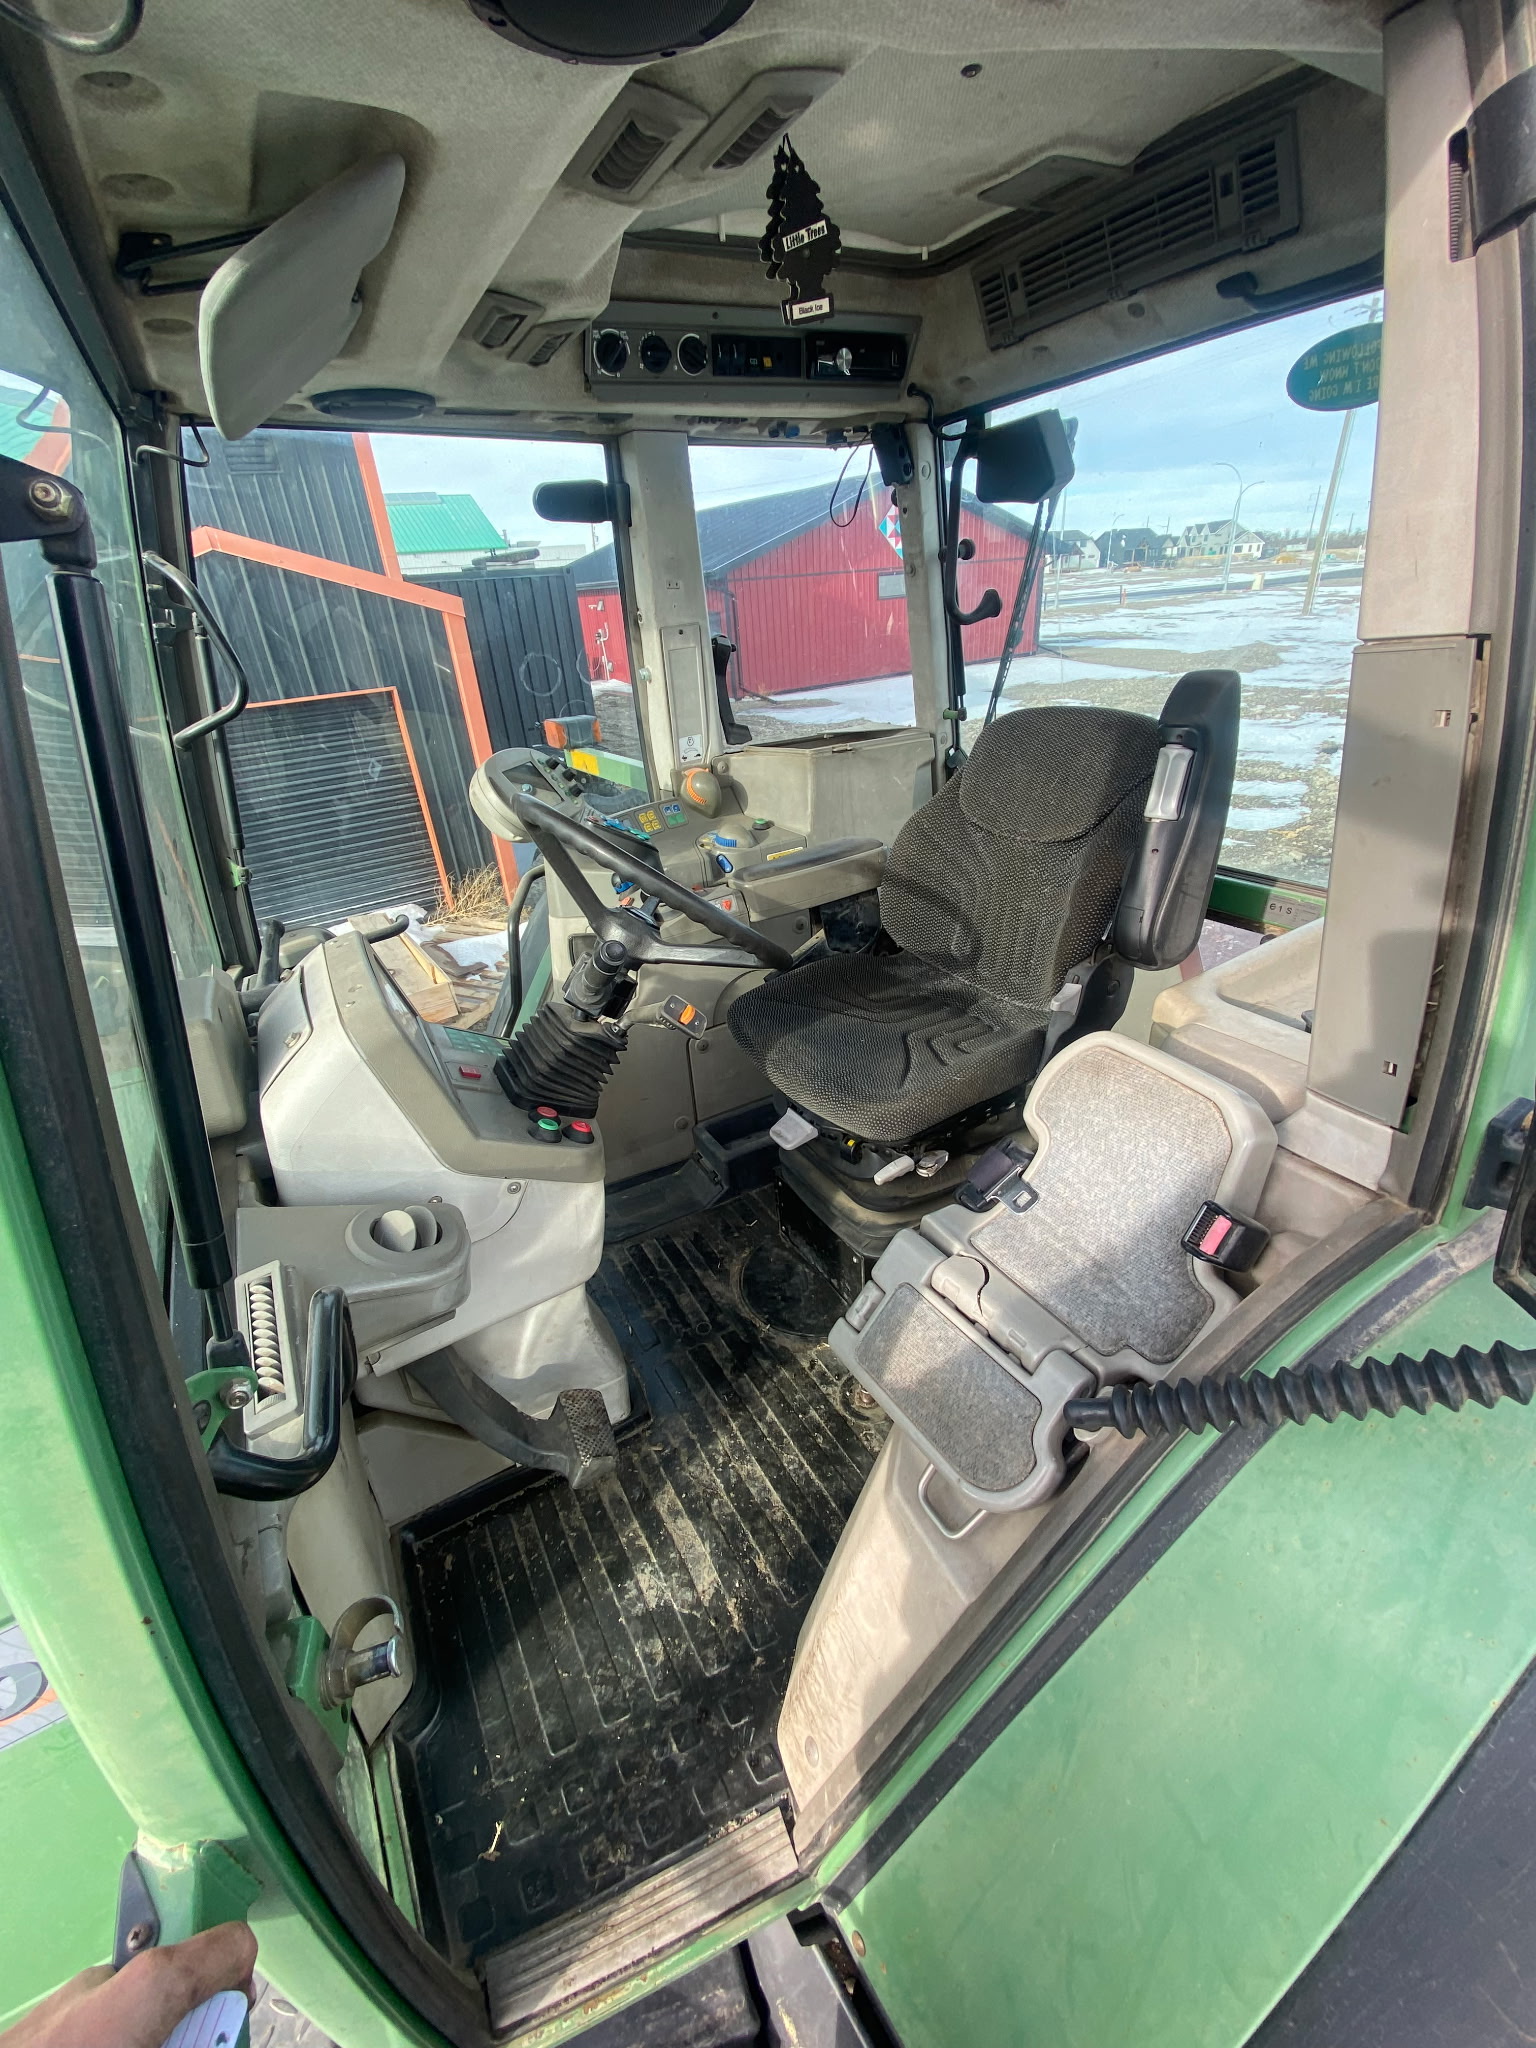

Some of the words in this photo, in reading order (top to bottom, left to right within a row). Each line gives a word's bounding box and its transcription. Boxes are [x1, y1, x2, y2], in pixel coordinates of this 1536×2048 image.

[785, 231, 805, 250] Little
[805, 225, 826, 241] Trees
[799, 305, 814, 315] Black
[815, 303, 823, 311] Ice
